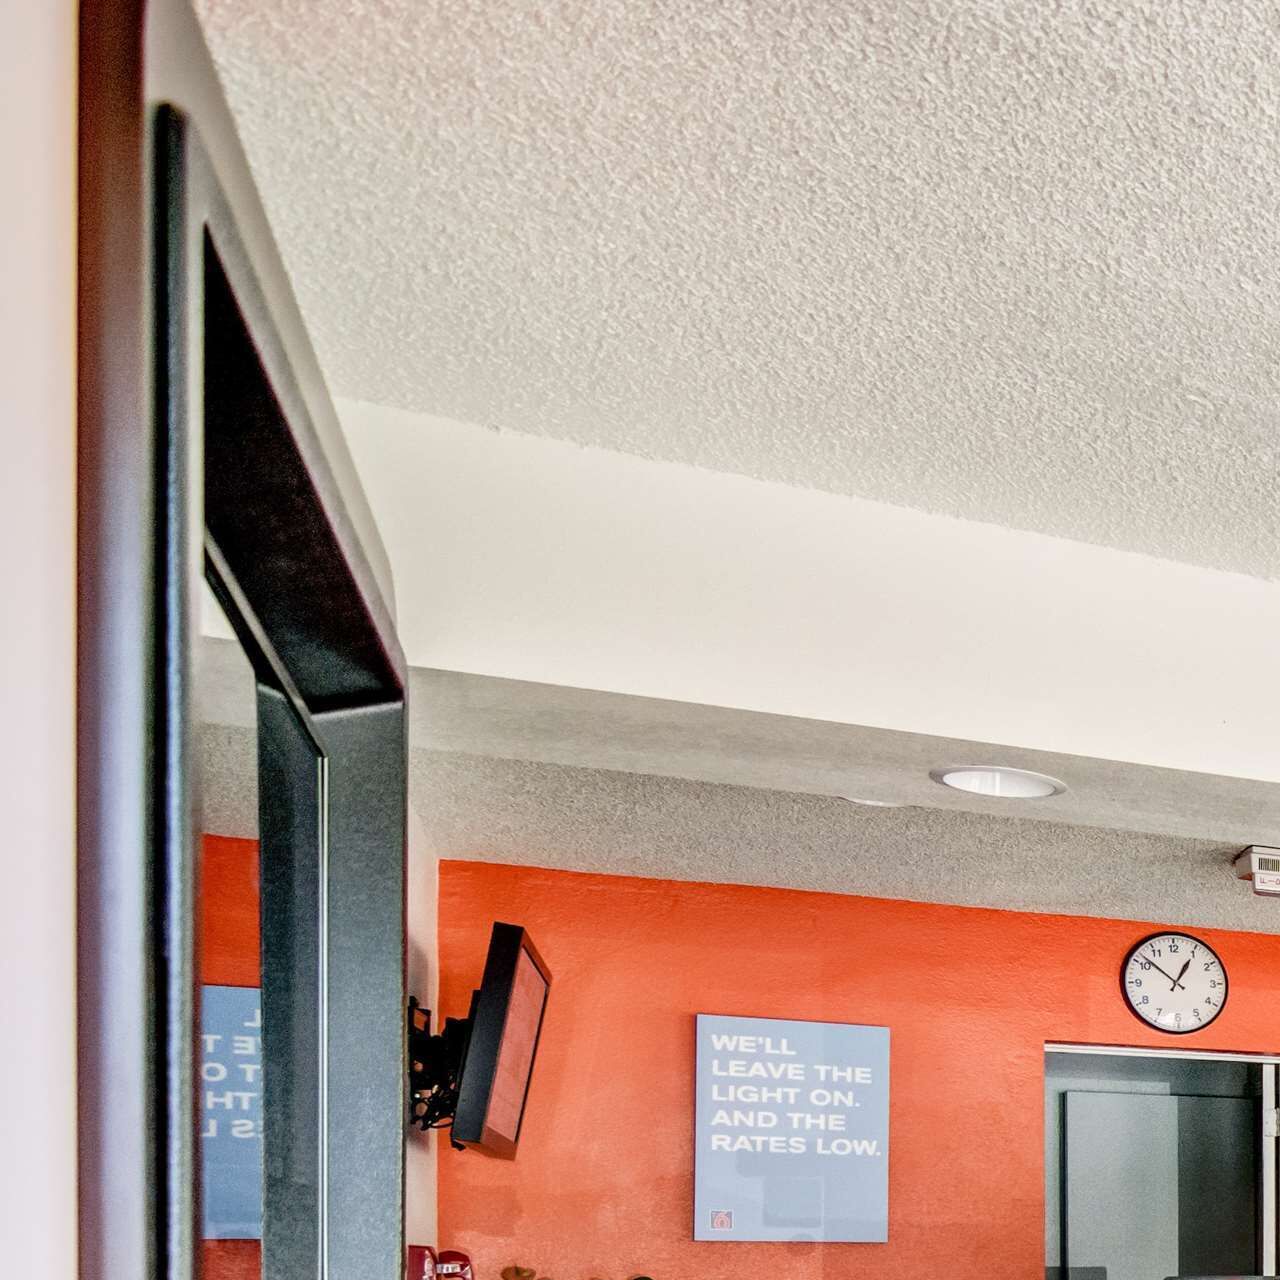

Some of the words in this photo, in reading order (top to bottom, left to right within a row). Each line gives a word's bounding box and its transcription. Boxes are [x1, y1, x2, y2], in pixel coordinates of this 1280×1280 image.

[1152, 949, 1161, 957] 11
[1169, 944, 1178, 953] 12
[1191, 950, 1195, 958] 1
[1140, 961, 1152, 970] 10
[1203, 962, 1210, 971] 2
[1134, 978, 1142, 987] 9
[1209, 980, 1216, 988] 3
[1142, 995, 1149, 1004] 8
[1205, 996, 1211, 1005] 4
[1193, 1008, 1200, 1017] 5
[711, 1034, 797, 1055] WE'LL
[711, 1060, 805, 1080] LEAVE
[814, 1065, 872, 1084] THE
[711, 1085, 800, 1104] LIGHT
[809, 1089, 860, 1107] ON.
[711, 1110, 778, 1128] AND
[787, 1113, 846, 1131] THE
[711, 1134, 806, 1153] RATES
[817, 1138, 881, 1156] LOW.
